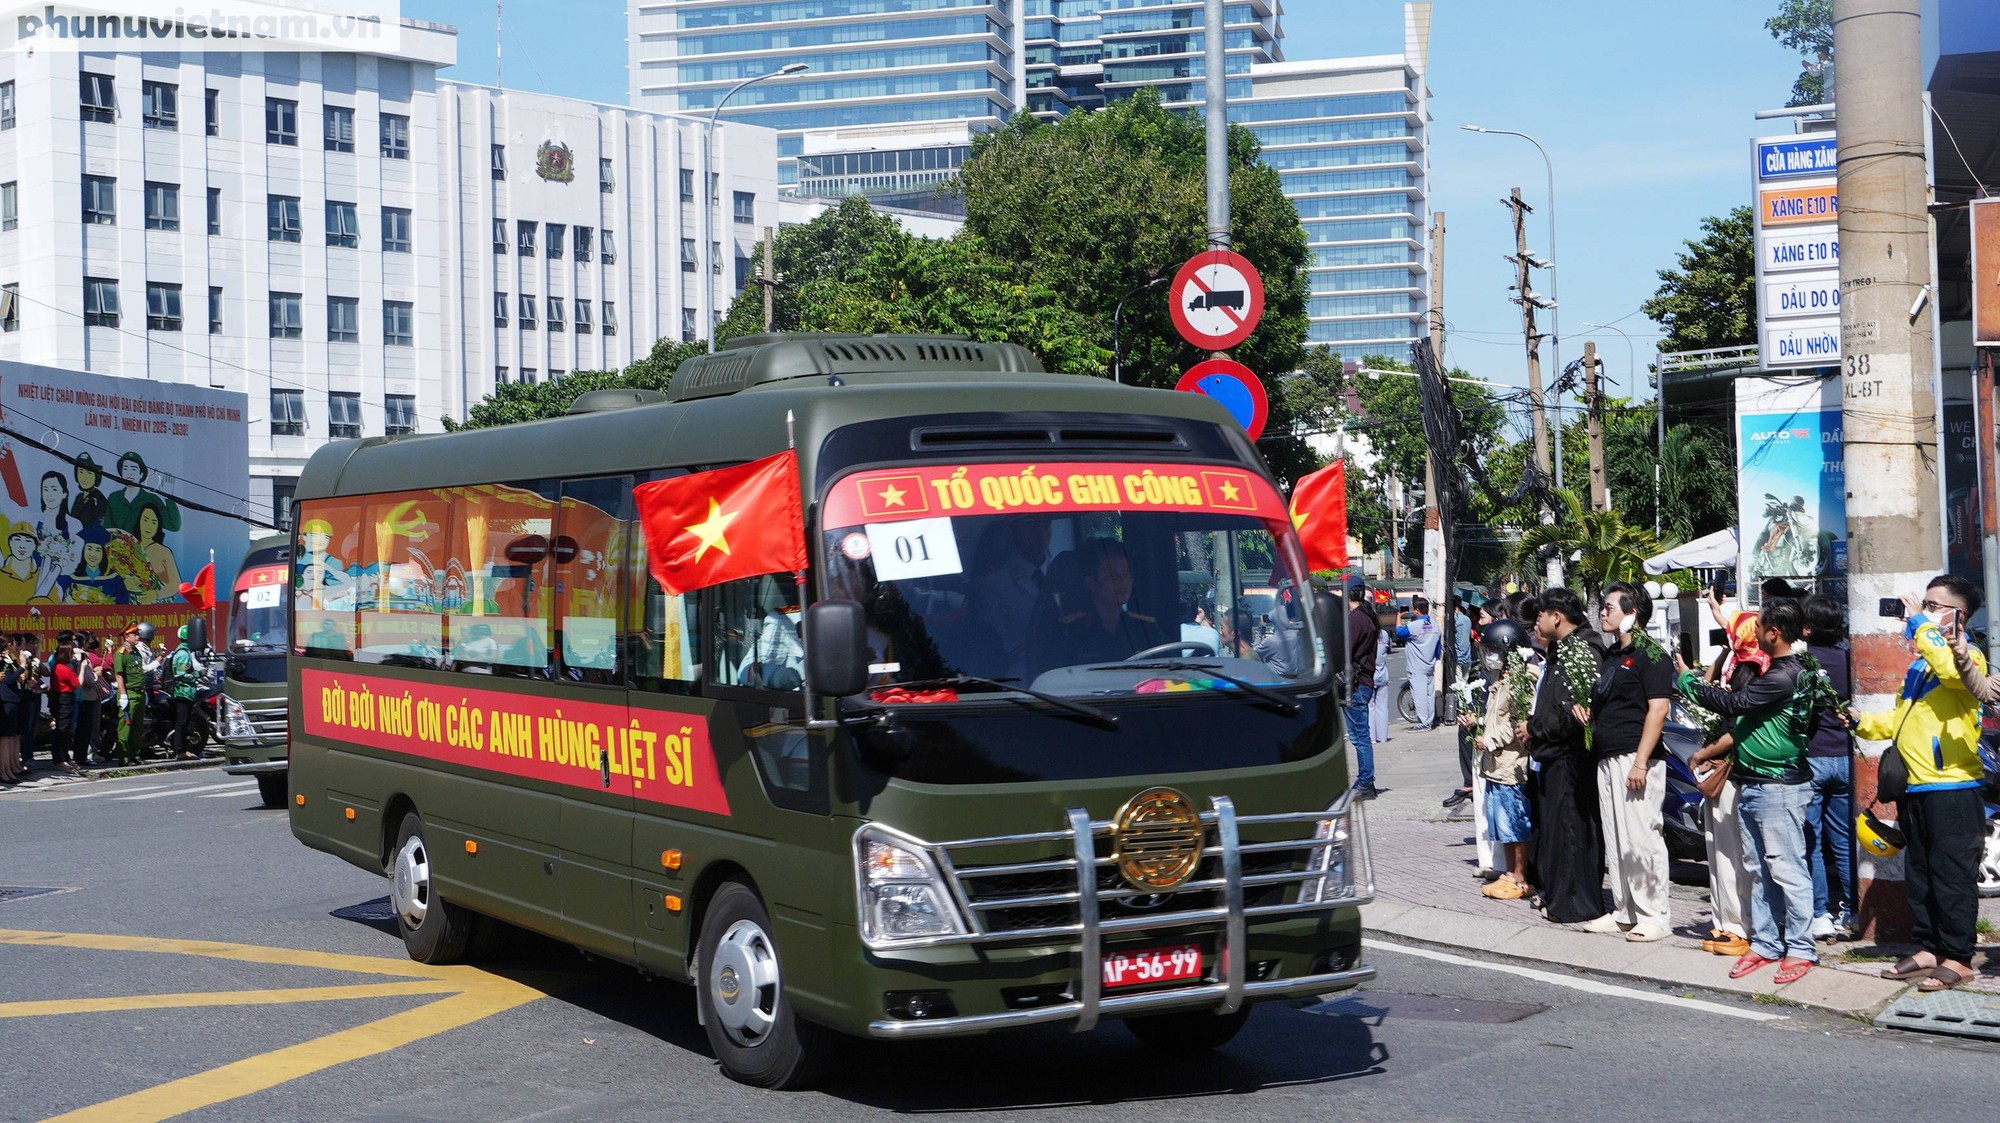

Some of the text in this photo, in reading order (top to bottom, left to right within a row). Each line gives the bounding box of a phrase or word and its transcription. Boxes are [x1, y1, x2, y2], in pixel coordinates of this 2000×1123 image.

[1766, 145, 1838, 172] CỬA HÀNG XĂN
[1771, 196, 1804, 217] XĂNG
[1807, 196, 1826, 214] E10
[1773, 242, 1804, 263] XĂNG
[1808, 242, 1827, 260] E10
[1781, 284, 1807, 310] DẦU
[1811, 289, 1828, 308] DO
[1780, 330, 1838, 357] DẦU NHỜN
[1846, 354, 1870, 377] 38
[18, 382, 241, 422] NHIỆT LIỆT CHÀO MỪNG ĐẠI HỘI ĐẠI BIỂU ĐẢNG BỘ THÀNH PHỐ HỒ CHÍ MINH
[85, 408, 98, 427] LẦN
[99, 412, 112, 429] THỨ
[122, 416, 142, 435] NHIỆM
[143, 417, 151, 433] KỲ
[152, 421, 167, 434] 2025
[1949, 421, 1971, 433] WE
[931, 465, 1204, 511] TỔ QUỐC GHI CÔNG
[895, 534, 934, 563] 01
[257, 591, 271, 602] 02
[48, 613, 72, 630] LÒNG
[74, 615, 104, 629] CHUNG
[106, 613, 123, 629] SỨC
[167, 612, 179, 627] VÀ
[322, 679, 694, 789] ĐỜI ĐỜI NHỚ ƠN CÁC ANH HÙNG LIỆT SĨ
